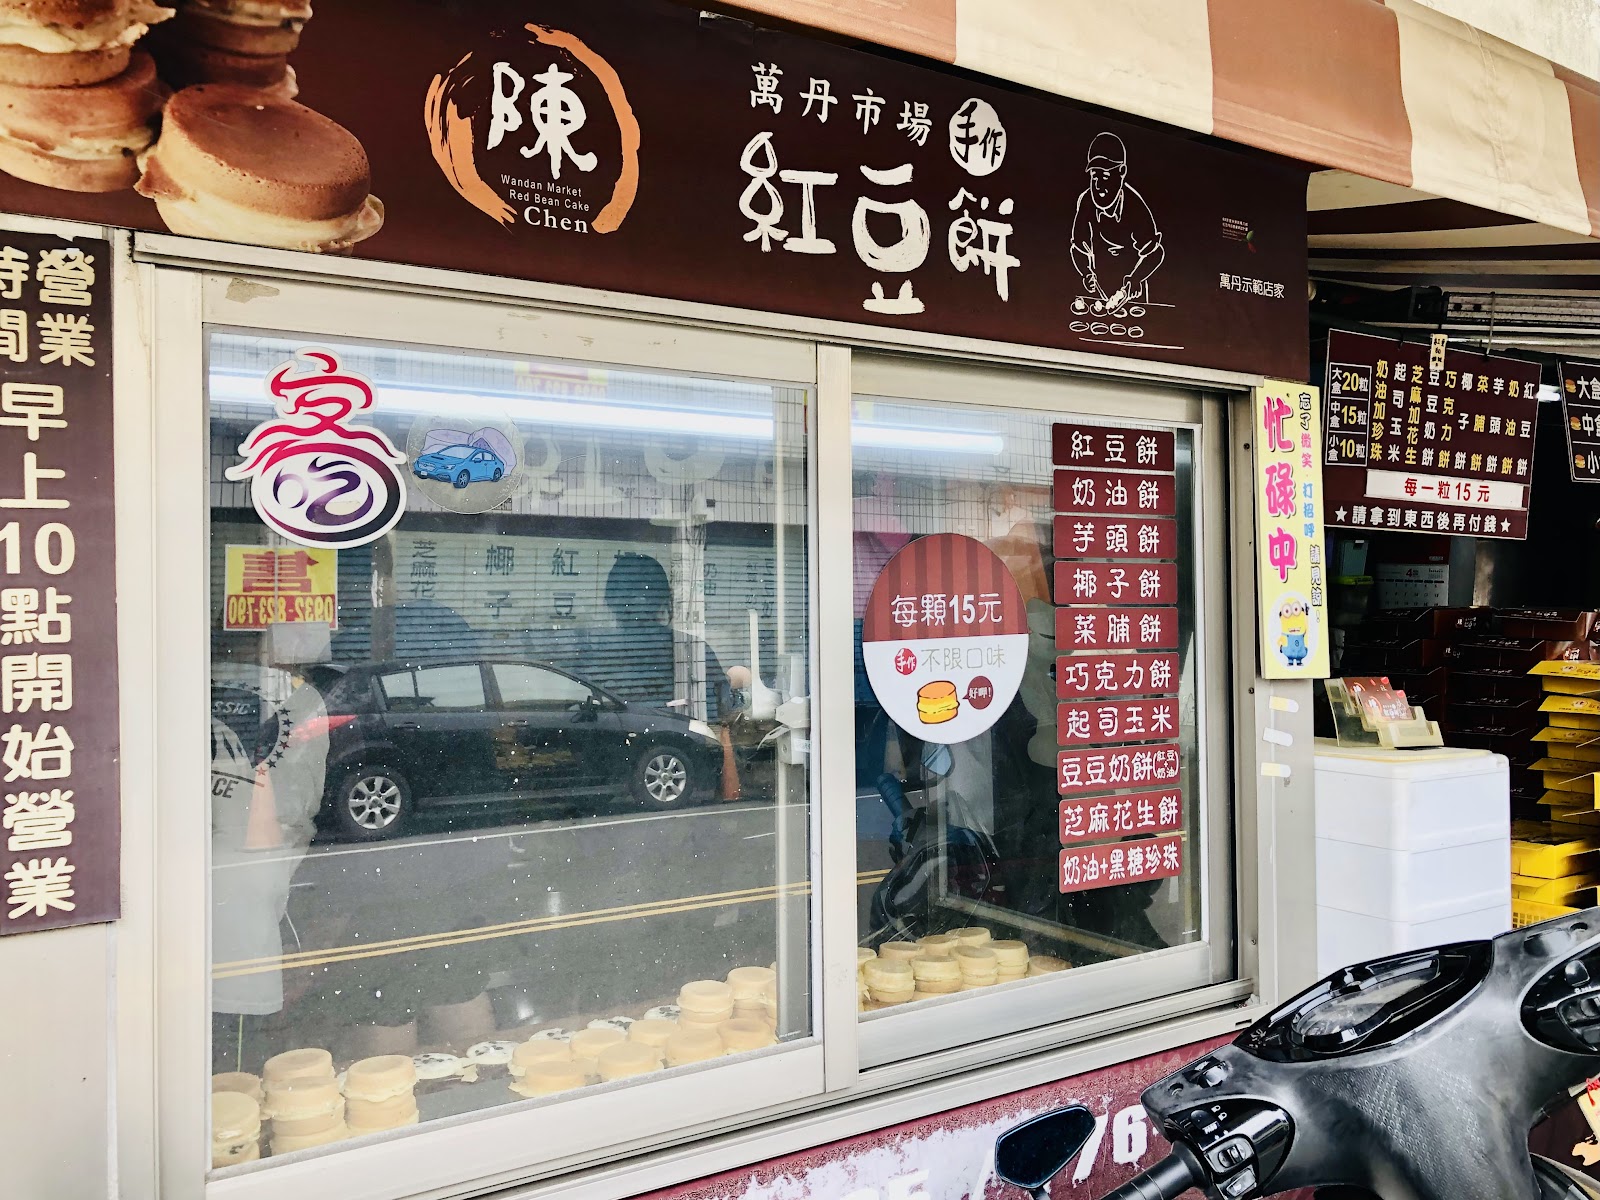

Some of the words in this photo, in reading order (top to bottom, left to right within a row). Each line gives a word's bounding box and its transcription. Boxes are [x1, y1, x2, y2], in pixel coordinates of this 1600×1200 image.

[487, 62, 597, 179] 陳
[750, 62, 933, 146] 萬丹市場
[953, 101, 1003, 168] 手作
[501, 174, 542, 190] Wandan
[547, 182, 581, 197] Market
[509, 189, 529, 202] Red
[535, 193, 560, 206] Bean
[564, 199, 590, 212] Cake
[524, 206, 588, 234] Chen
[738, 132, 1020, 315] 紅豆餅
[1219, 272, 1285, 299] 萬丹示範店家
[1369, 359, 1388, 462] 奶油加珍珠
[1387, 362, 1407, 463] 起司玉米
[1404, 365, 1424, 465] 芝麻加花生
[1421, 369, 1440, 467] 豆豆奶餅
[1438, 370, 1457, 469] 巧克力餅
[1454, 372, 1473, 470] 椰子餅
[1470, 375, 1489, 472] 菜脯餅
[1486, 377, 1504, 473] 芋頭餅
[1501, 379, 1519, 475] 奶油餅
[1516, 382, 1535, 477] 紅豆餅
[1070, 430, 1158, 465] 紅豆餅
[1072, 477, 1160, 509] 奶油餅
[1263, 395, 1298, 583] 忙碌中
[1072, 522, 1160, 554] 芋頭餅
[1351, 505, 1498, 533] 請拿到東西後再付錢
[1073, 568, 1161, 599] 椰子餅
[890, 593, 1003, 627] 每顆15元
[1074, 613, 1161, 645] 菜脯餅
[921, 644, 1006, 673] 不限口味
[1065, 659, 1172, 692] 巧克力餅
[1066, 704, 1173, 738] 起司玉米
[1064, 795, 1178, 836] 芝麻花生餅
[1063, 841, 1180, 885] 奶油+黑糖珍珠
